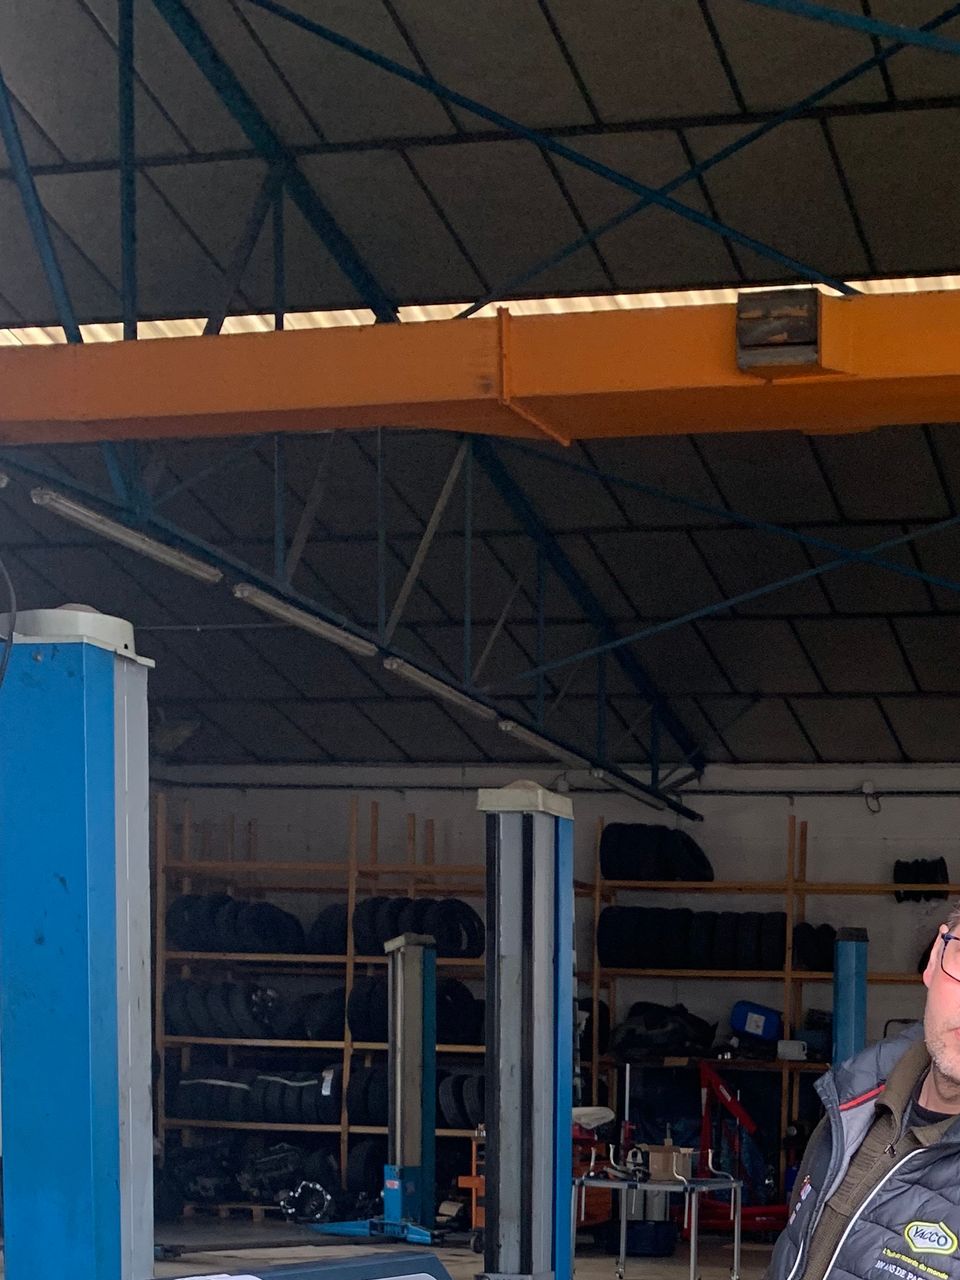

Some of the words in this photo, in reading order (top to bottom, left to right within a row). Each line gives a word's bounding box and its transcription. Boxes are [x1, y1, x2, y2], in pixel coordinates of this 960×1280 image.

[914, 1226, 948, 1247] YACCO
[895, 1266, 907, 1278] DE
[927, 1267, 949, 1280] monde
